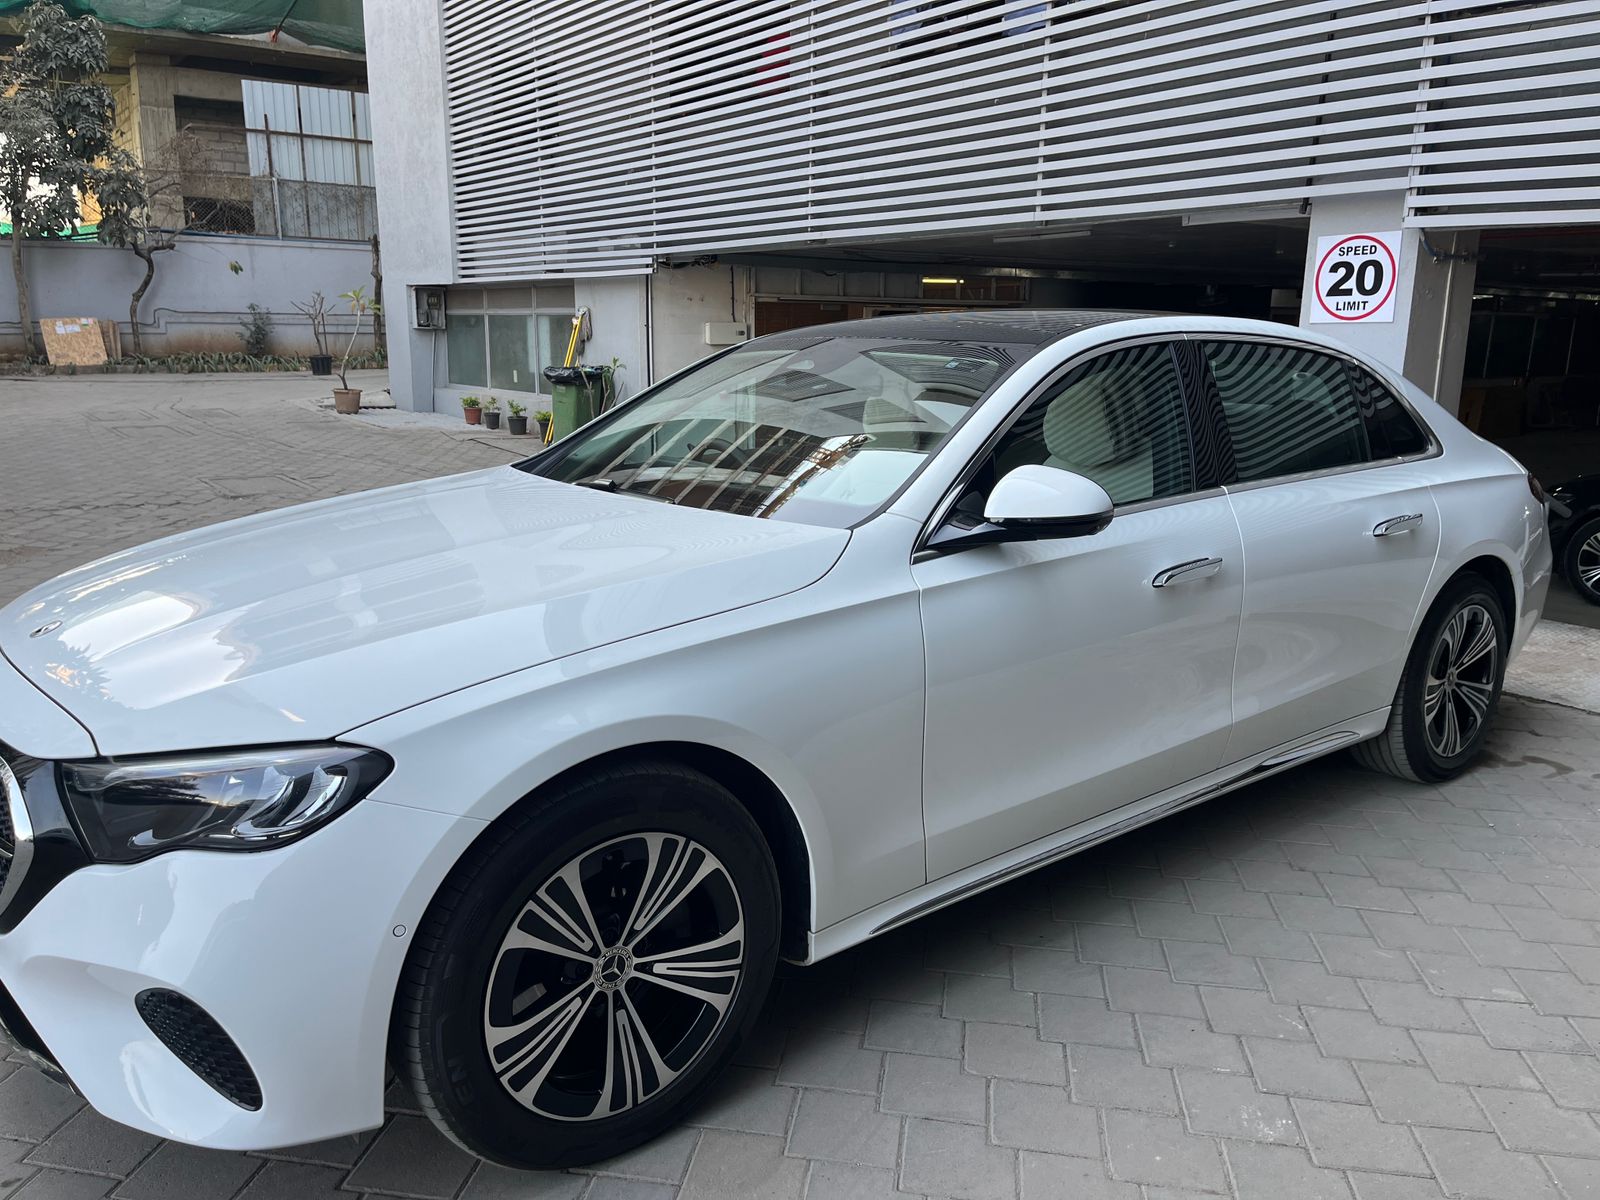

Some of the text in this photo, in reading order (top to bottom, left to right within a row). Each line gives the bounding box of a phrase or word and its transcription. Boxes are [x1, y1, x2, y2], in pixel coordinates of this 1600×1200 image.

[1338, 245, 1377, 256] SPEED
[1325, 259, 1384, 297] 20
[1335, 301, 1368, 311] LIMIT
